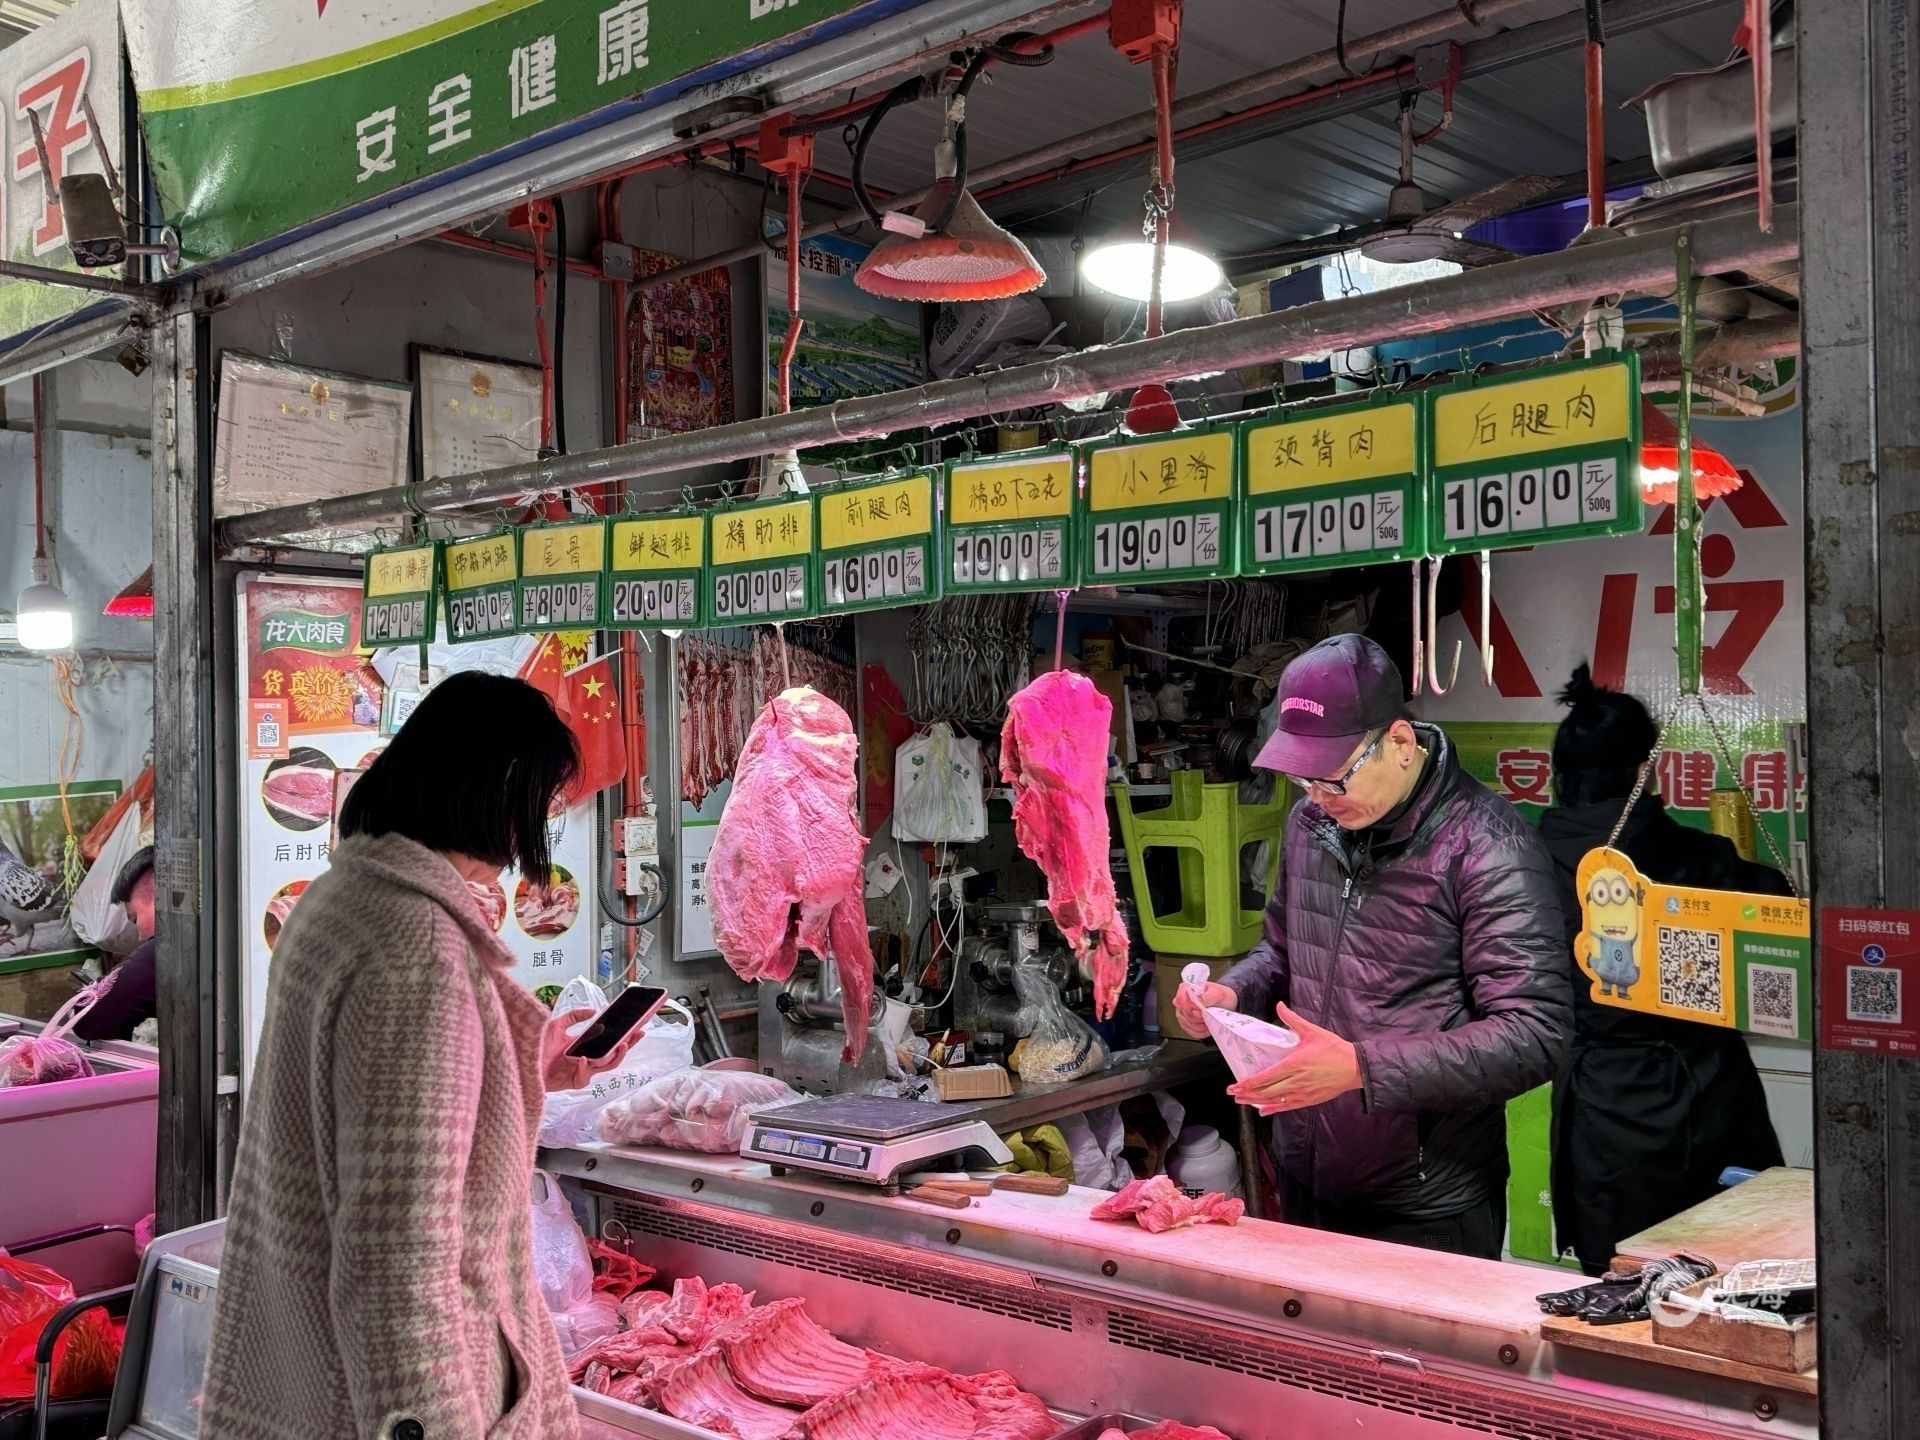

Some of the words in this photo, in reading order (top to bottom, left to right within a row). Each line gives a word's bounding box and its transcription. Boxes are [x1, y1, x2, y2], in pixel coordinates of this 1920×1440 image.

[355, 0, 651, 184] 安全健康
[1466, 384, 1596, 455] 后腿肉
[1272, 423, 1375, 469] 颈背肉
[845, 489, 913, 528] 前腿肉
[1447, 468, 1571, 531] 16.00
[725, 512, 799, 552] 精肋排
[1096, 519, 1187, 568] 19.00
[1256, 501, 1366, 555] 17.00
[542, 534, 582, 569] 尾骨
[716, 570, 783, 614] 30.00
[826, 554, 899, 601] 16.00
[451, 594, 499, 633] 25.00
[614, 581, 674, 618] 20.00
[265, 619, 345, 644] 龙大肉食
[367, 603, 410, 637] 12.00
[274, 843, 331, 862] 后肘肉
[1682, 898, 1711, 911] 支付宝
[1761, 905, 1804, 920] 微信支付
[1838, 918, 1910, 935] 扫码领红包
[532, 950, 564, 968] 腿骨
